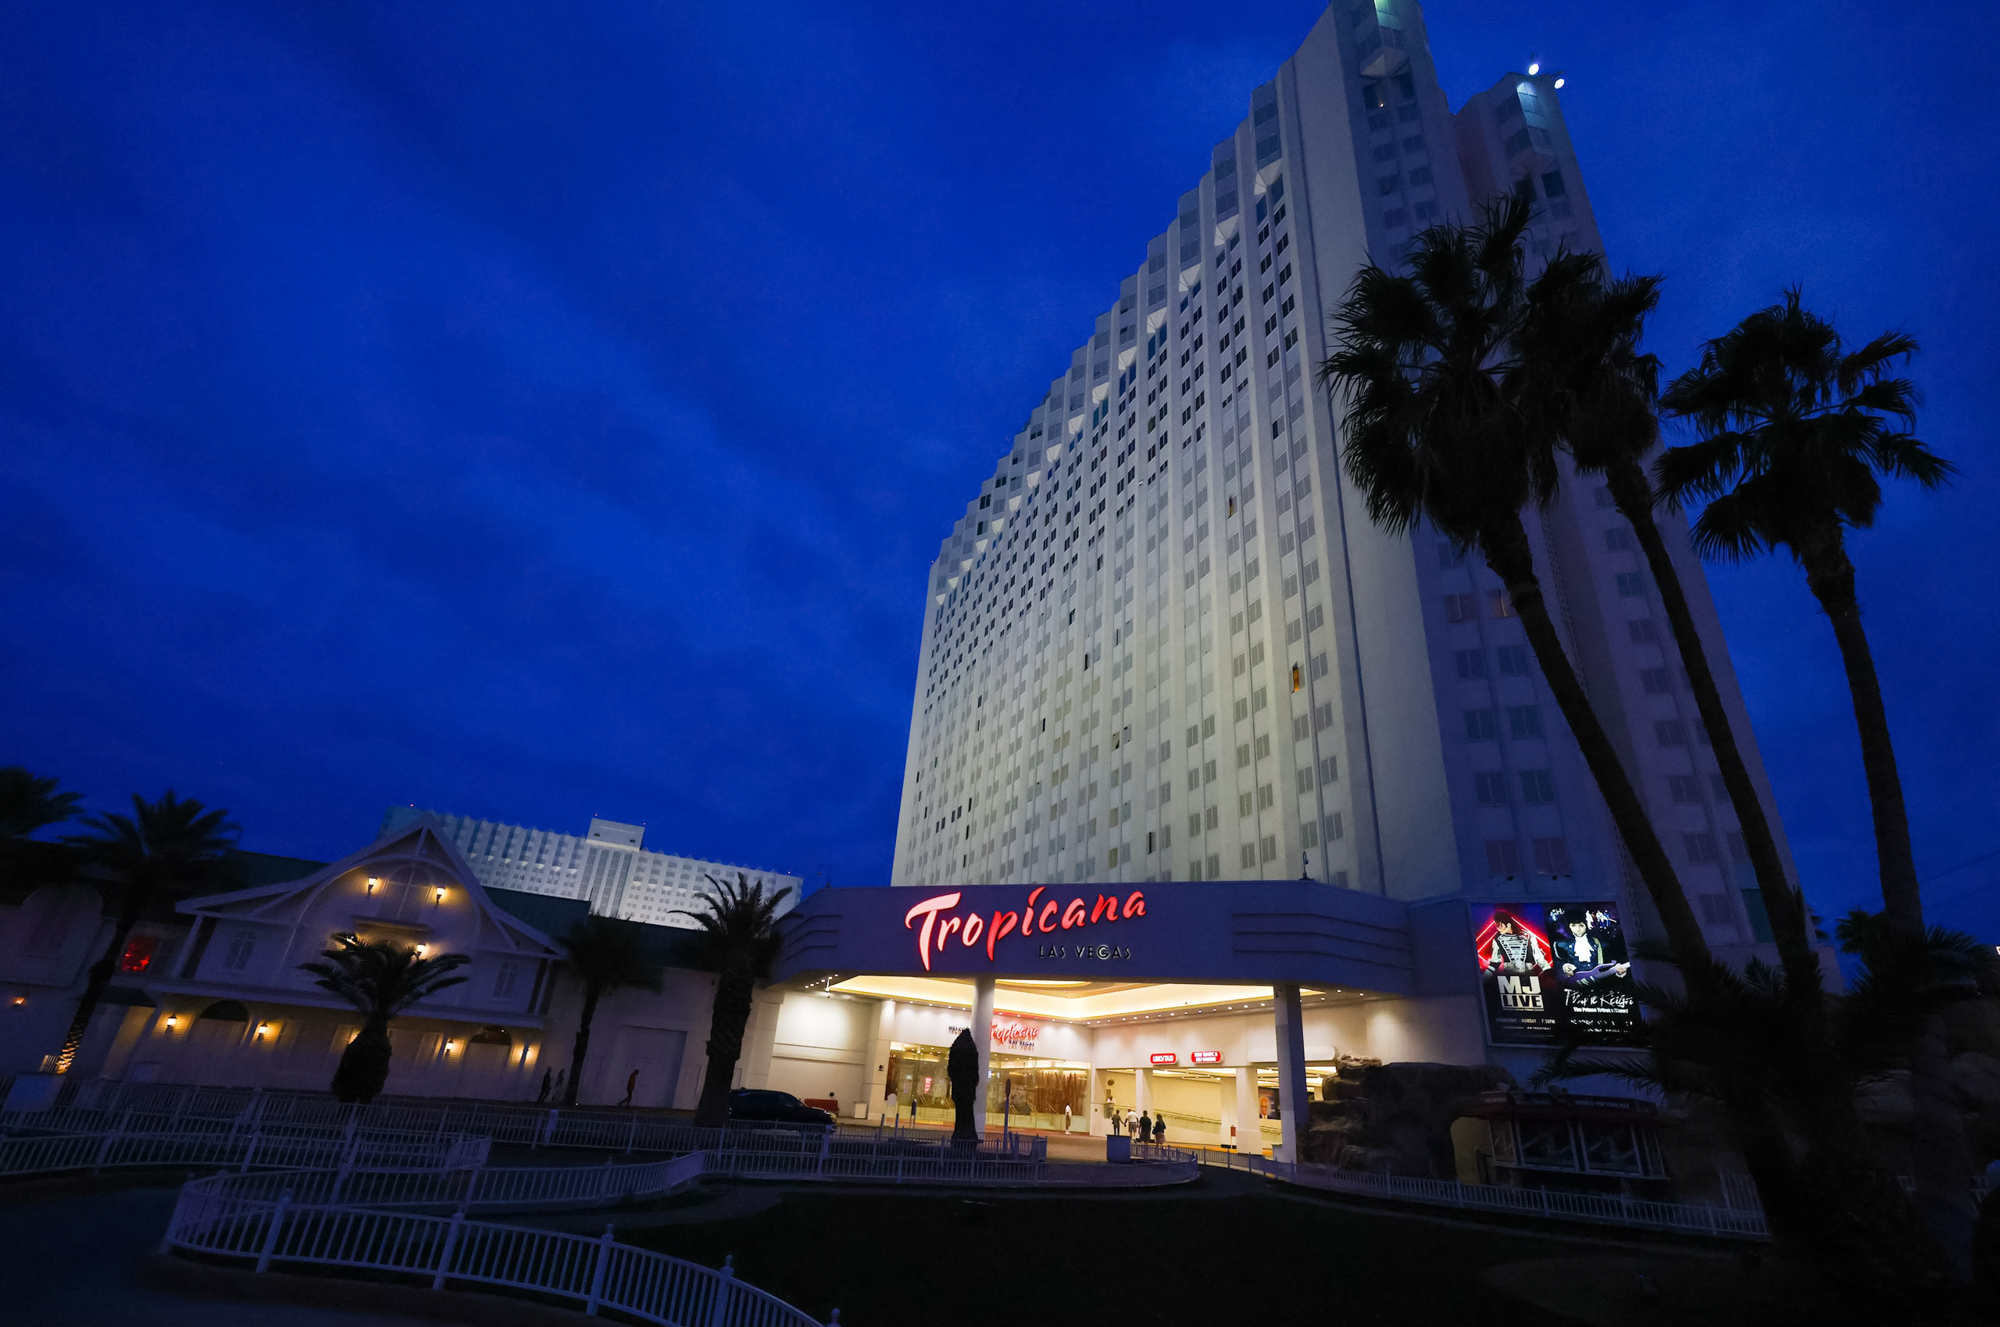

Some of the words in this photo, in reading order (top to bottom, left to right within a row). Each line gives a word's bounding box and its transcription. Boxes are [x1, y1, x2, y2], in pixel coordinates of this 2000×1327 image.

[905, 886, 1147, 971] Tropicana
[1039, 945, 1066, 959] LAS
[1075, 944, 1131, 960] VEGAS
[1497, 975, 1541, 994] MJ
[1502, 995, 1542, 1008] LIVE
